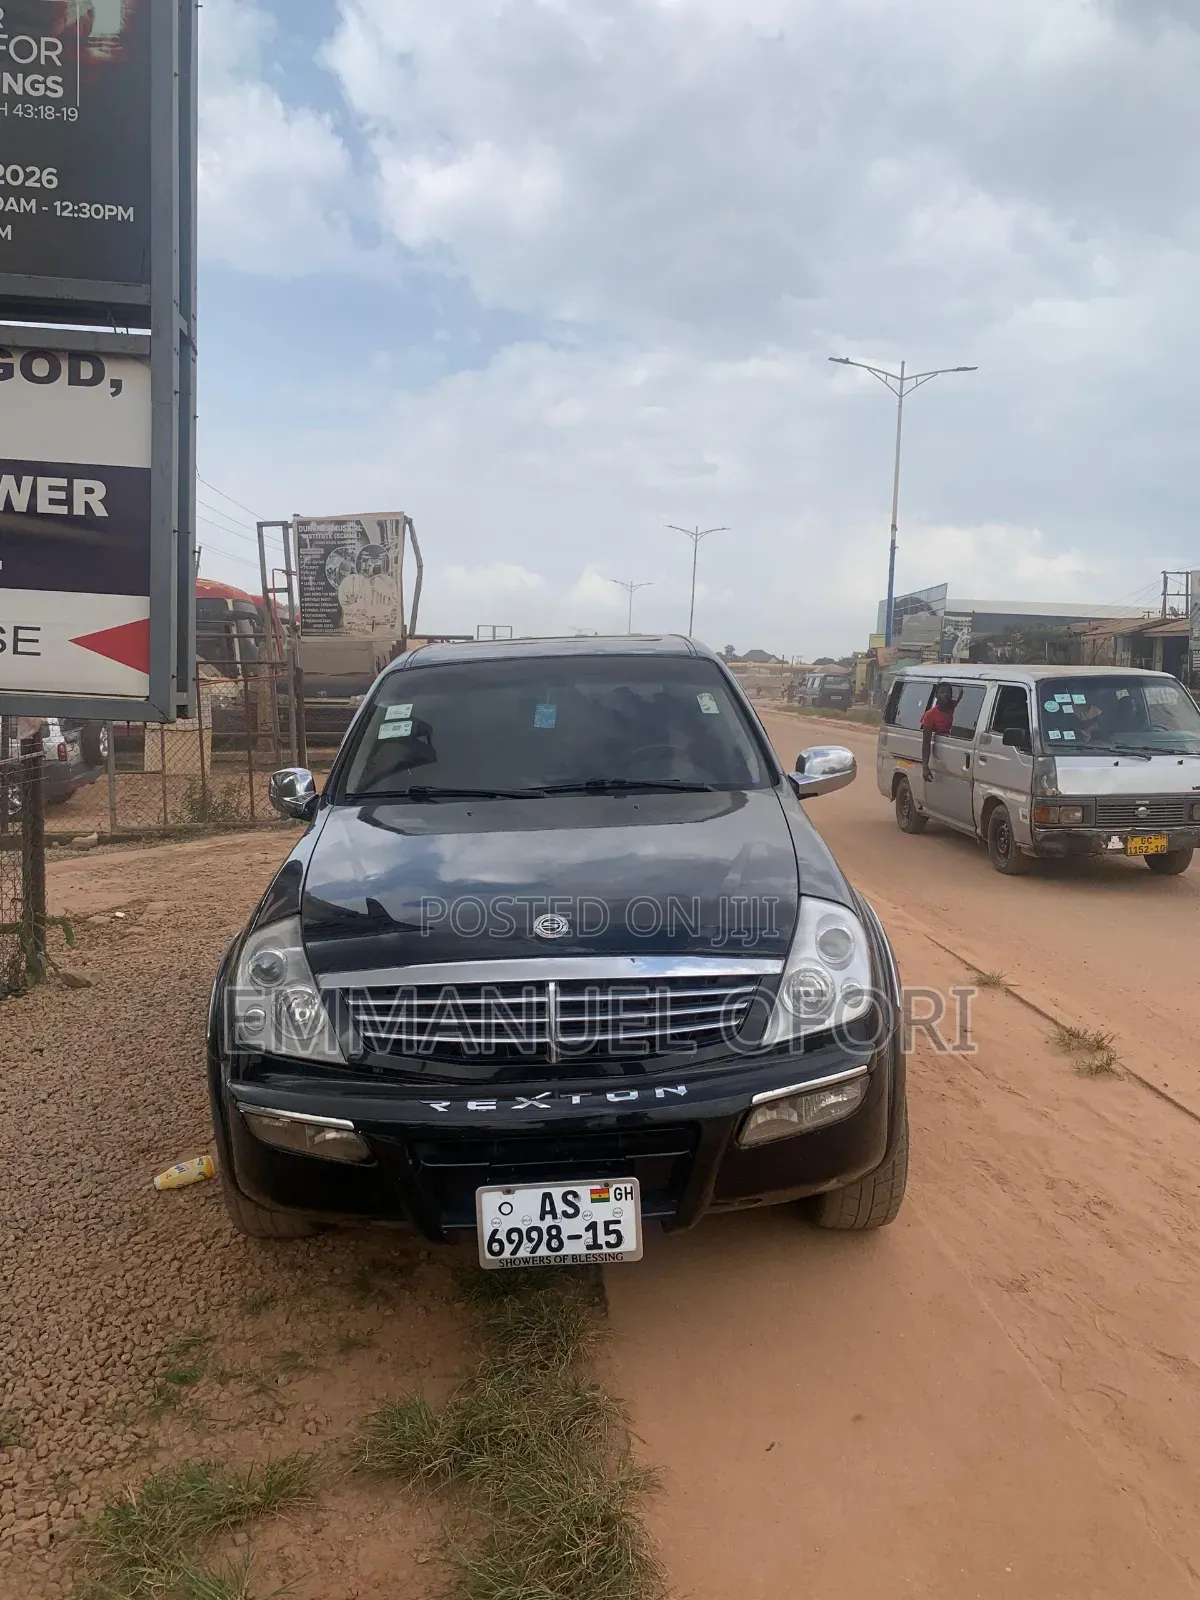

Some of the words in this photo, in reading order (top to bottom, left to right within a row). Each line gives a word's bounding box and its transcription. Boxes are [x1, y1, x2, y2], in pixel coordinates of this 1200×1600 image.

[3, 72, 64, 98] NGS
[13, 104, 79, 121] 43:18-19
[53, 201, 134, 222] 12:30PM
[0, 625, 42, 656] E
[419, 1084, 689, 1113] REXTON
[539, 1189, 581, 1222] AS
[613, 1186, 634, 1202] GH
[486, 1219, 624, 1257] 6998-15
[498, 1255, 552, 1268] SHOWERS
[553, 1254, 569, 1264] OF
[572, 1252, 624, 1264] BLESSING
